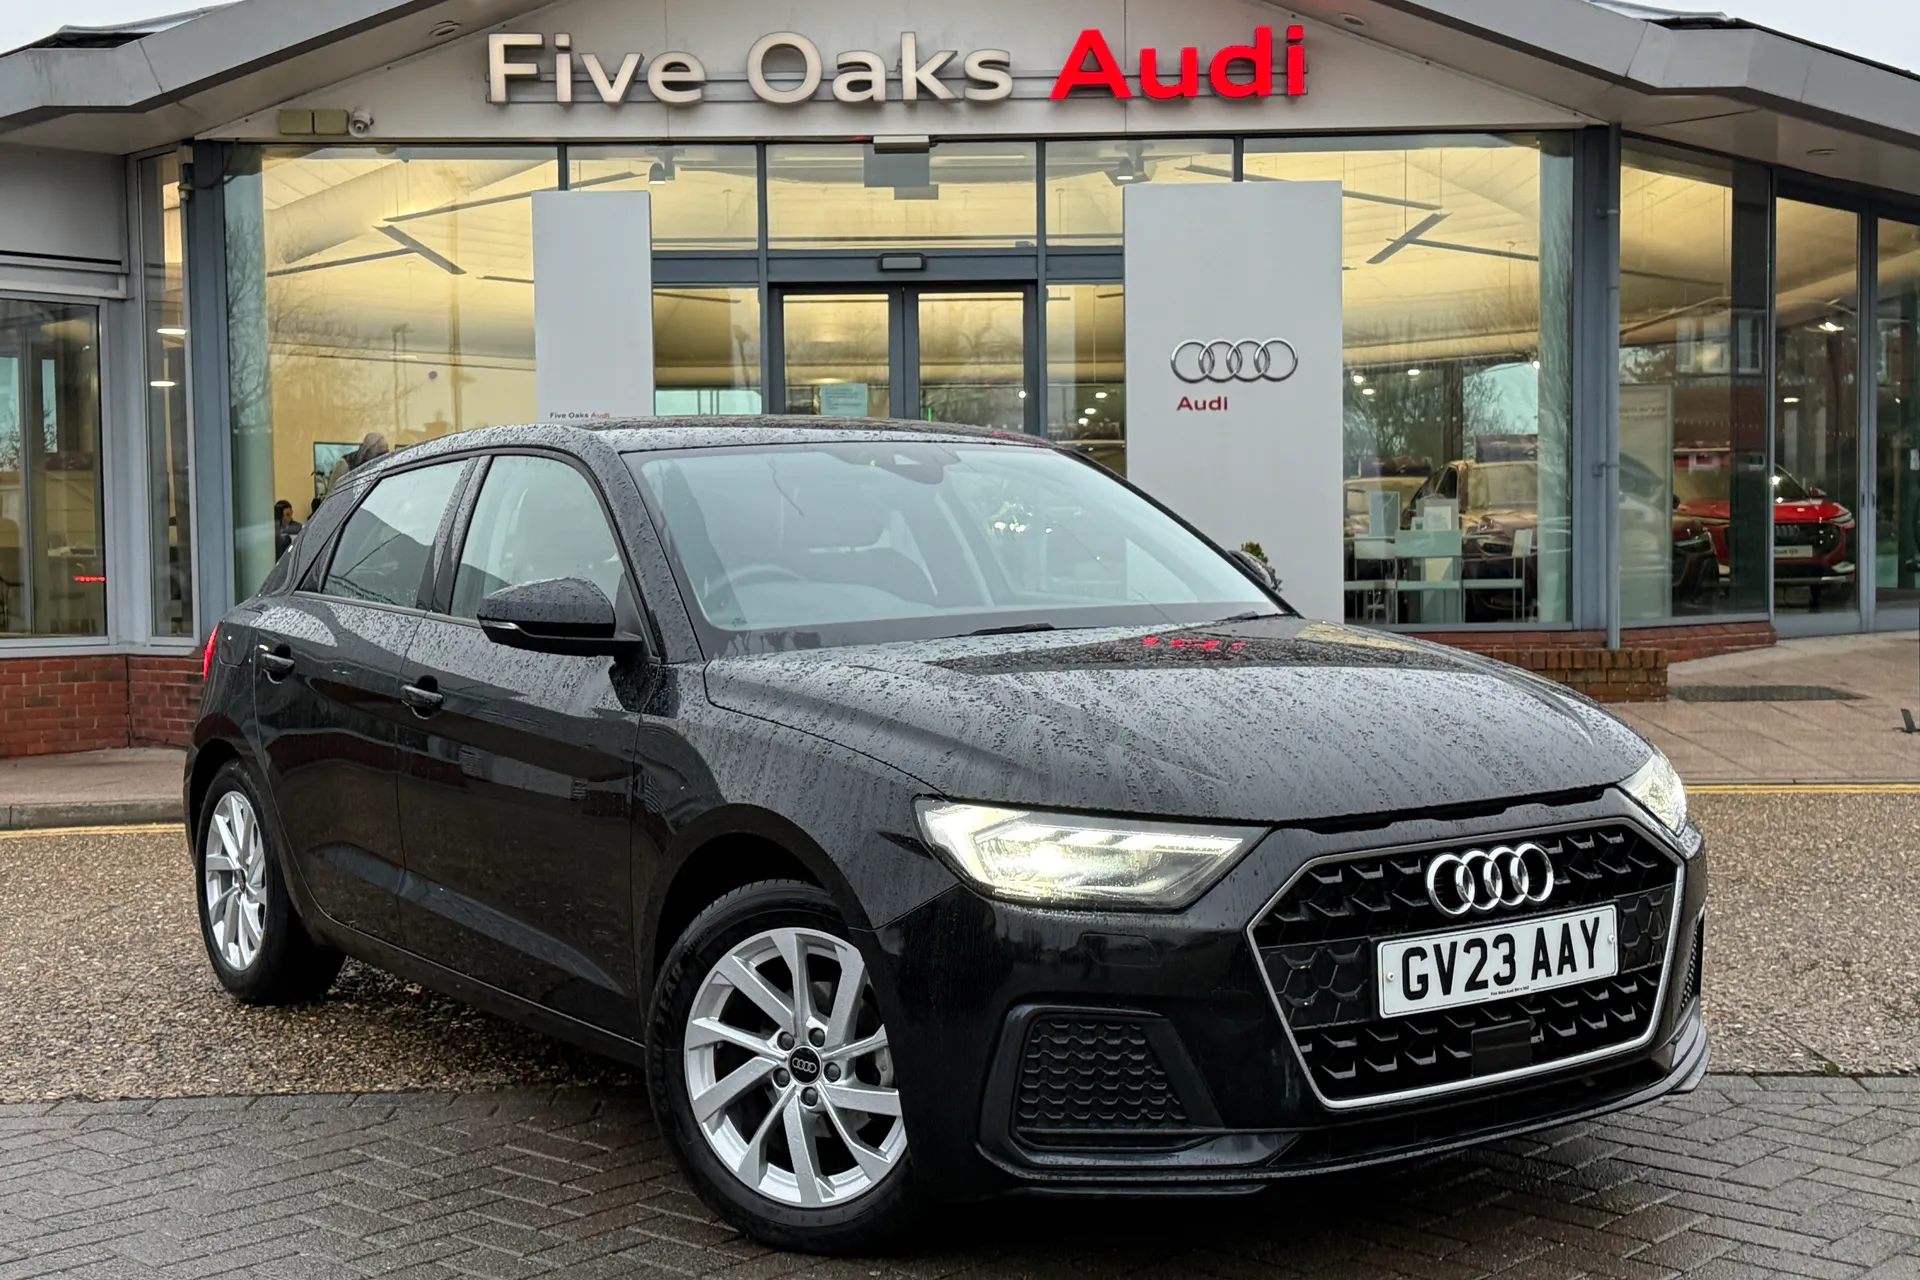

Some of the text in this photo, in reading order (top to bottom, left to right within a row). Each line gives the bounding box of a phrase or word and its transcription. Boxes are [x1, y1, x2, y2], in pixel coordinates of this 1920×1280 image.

[488, 26, 1305, 104] Five Oaks Audi
[549, 411, 610, 419] Five Oaks Audi
[1176, 395, 1228, 411] Audi
[1401, 916, 1600, 1001] GV23 AAY
